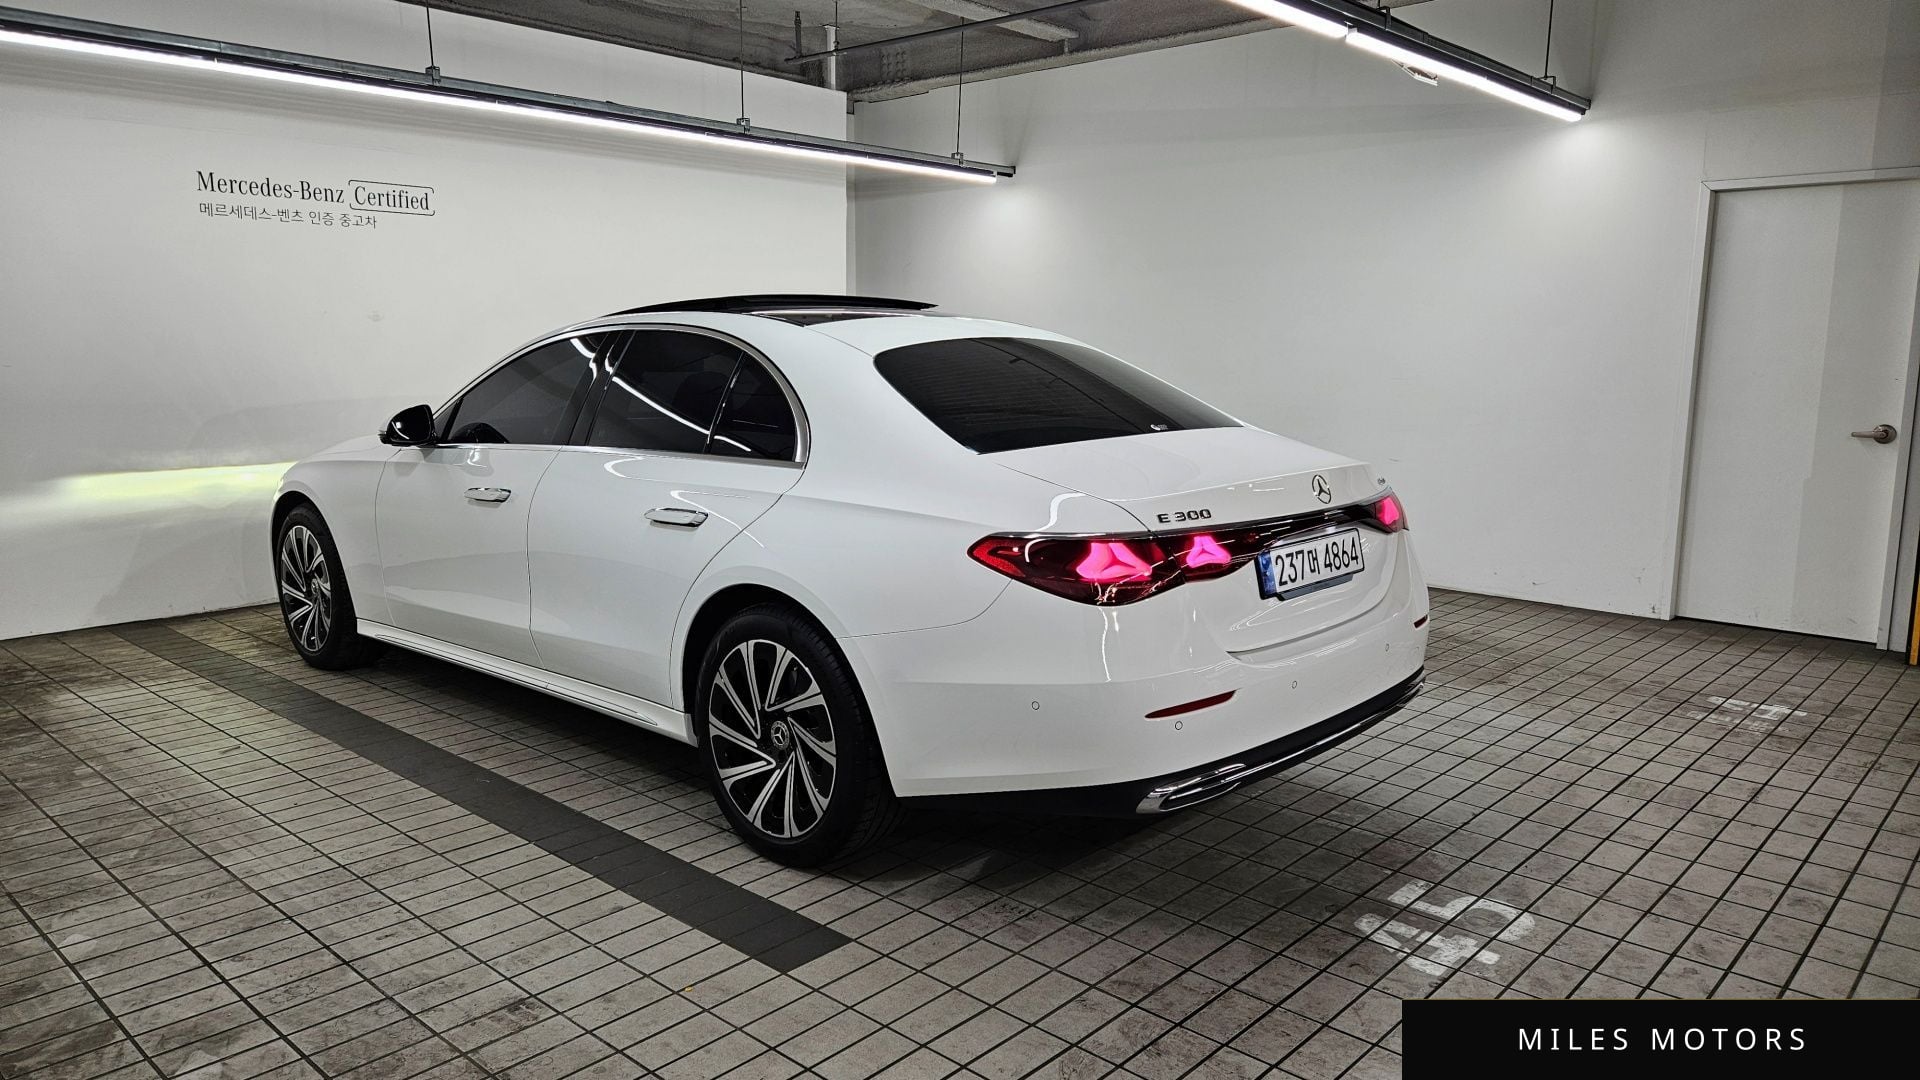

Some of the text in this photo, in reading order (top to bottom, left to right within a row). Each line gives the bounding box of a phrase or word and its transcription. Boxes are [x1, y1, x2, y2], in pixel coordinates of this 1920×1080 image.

[196, 170, 430, 210] Mercedes-Benz Certified
[199, 203, 377, 229] 메르세데스-벤츠 인증 중고차
[1157, 509, 1211, 523] E 300
[1324, 537, 1359, 572] 4864
